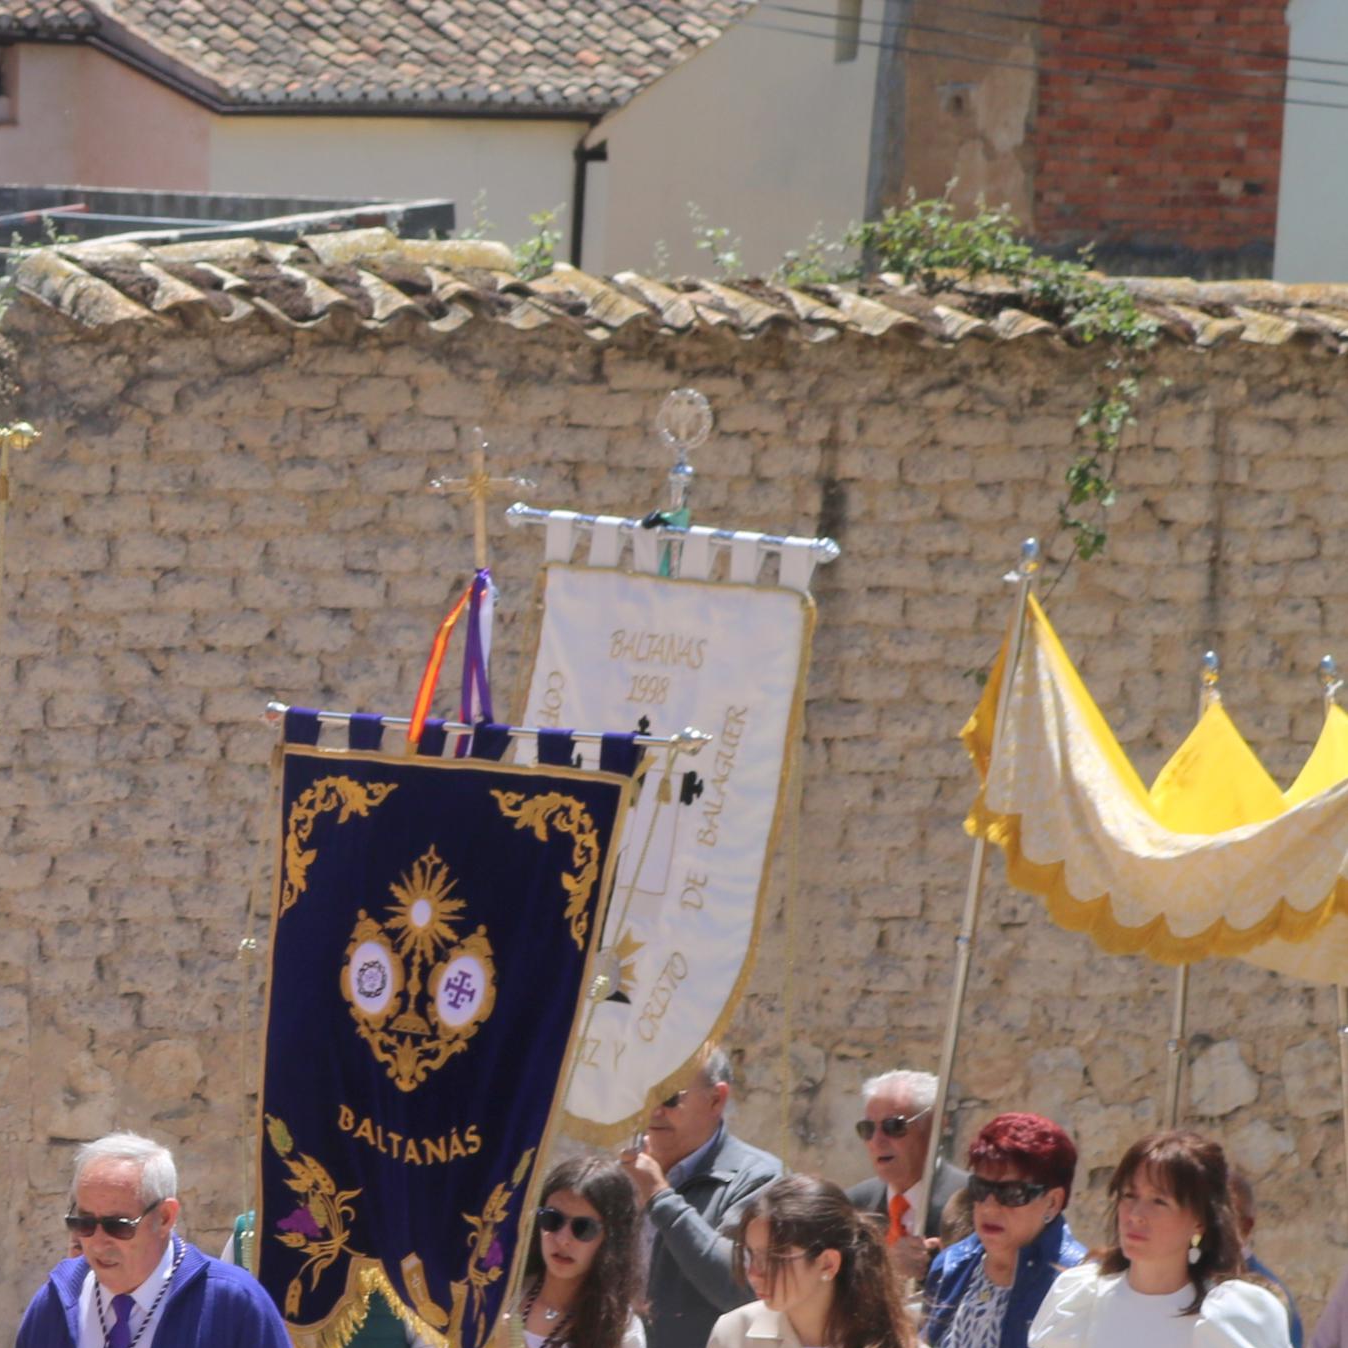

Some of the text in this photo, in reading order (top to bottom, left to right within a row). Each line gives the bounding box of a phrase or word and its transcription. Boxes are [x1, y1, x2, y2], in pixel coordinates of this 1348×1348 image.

[625, 673, 671, 705] 1998
[637, 951, 688, 1042] CRISTO
[679, 867, 709, 910] DE
[696, 705, 749, 848] BALAGUER
[337, 1103, 482, 1166] BALTANÁS
